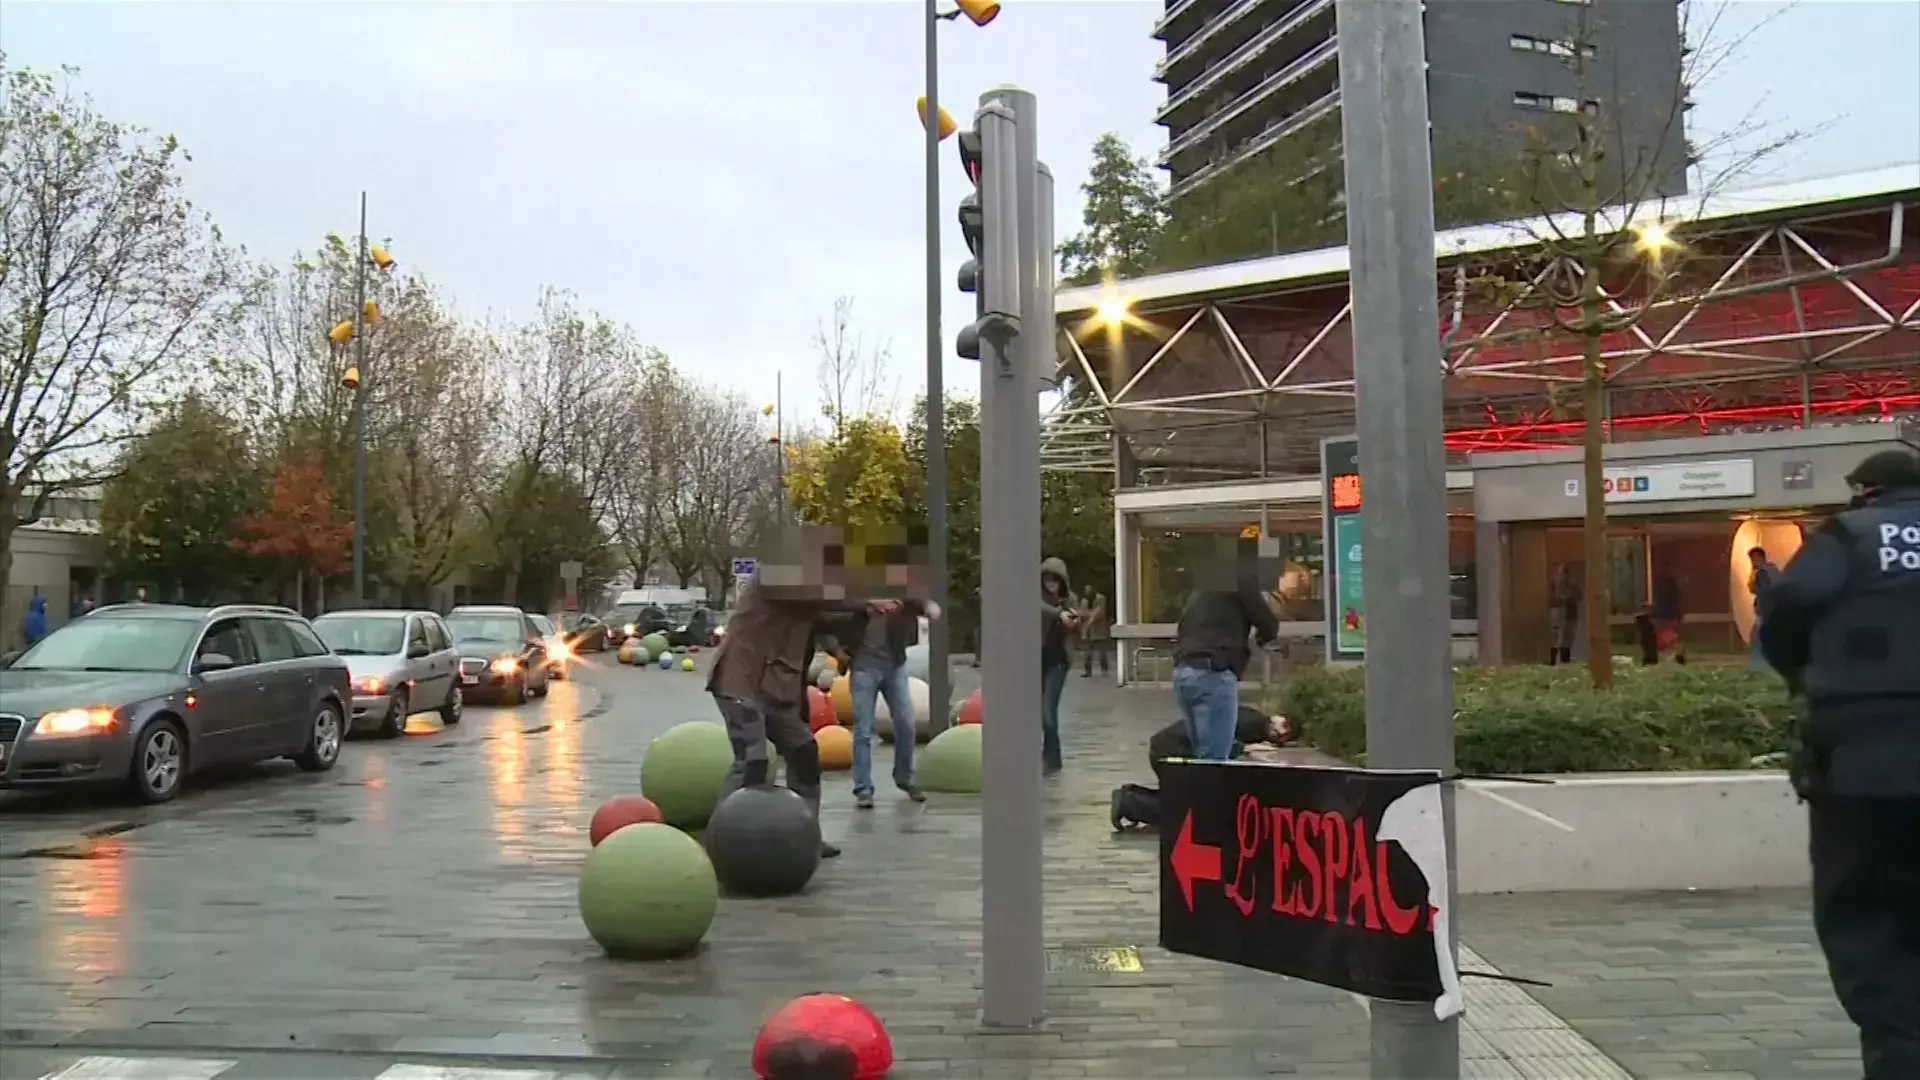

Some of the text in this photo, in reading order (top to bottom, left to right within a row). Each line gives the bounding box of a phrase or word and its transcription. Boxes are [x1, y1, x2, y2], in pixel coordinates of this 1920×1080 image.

[1878, 521, 1920, 545] Po
[1878, 545, 1920, 571] Po
[1224, 793, 1440, 934] L'ESPAC
